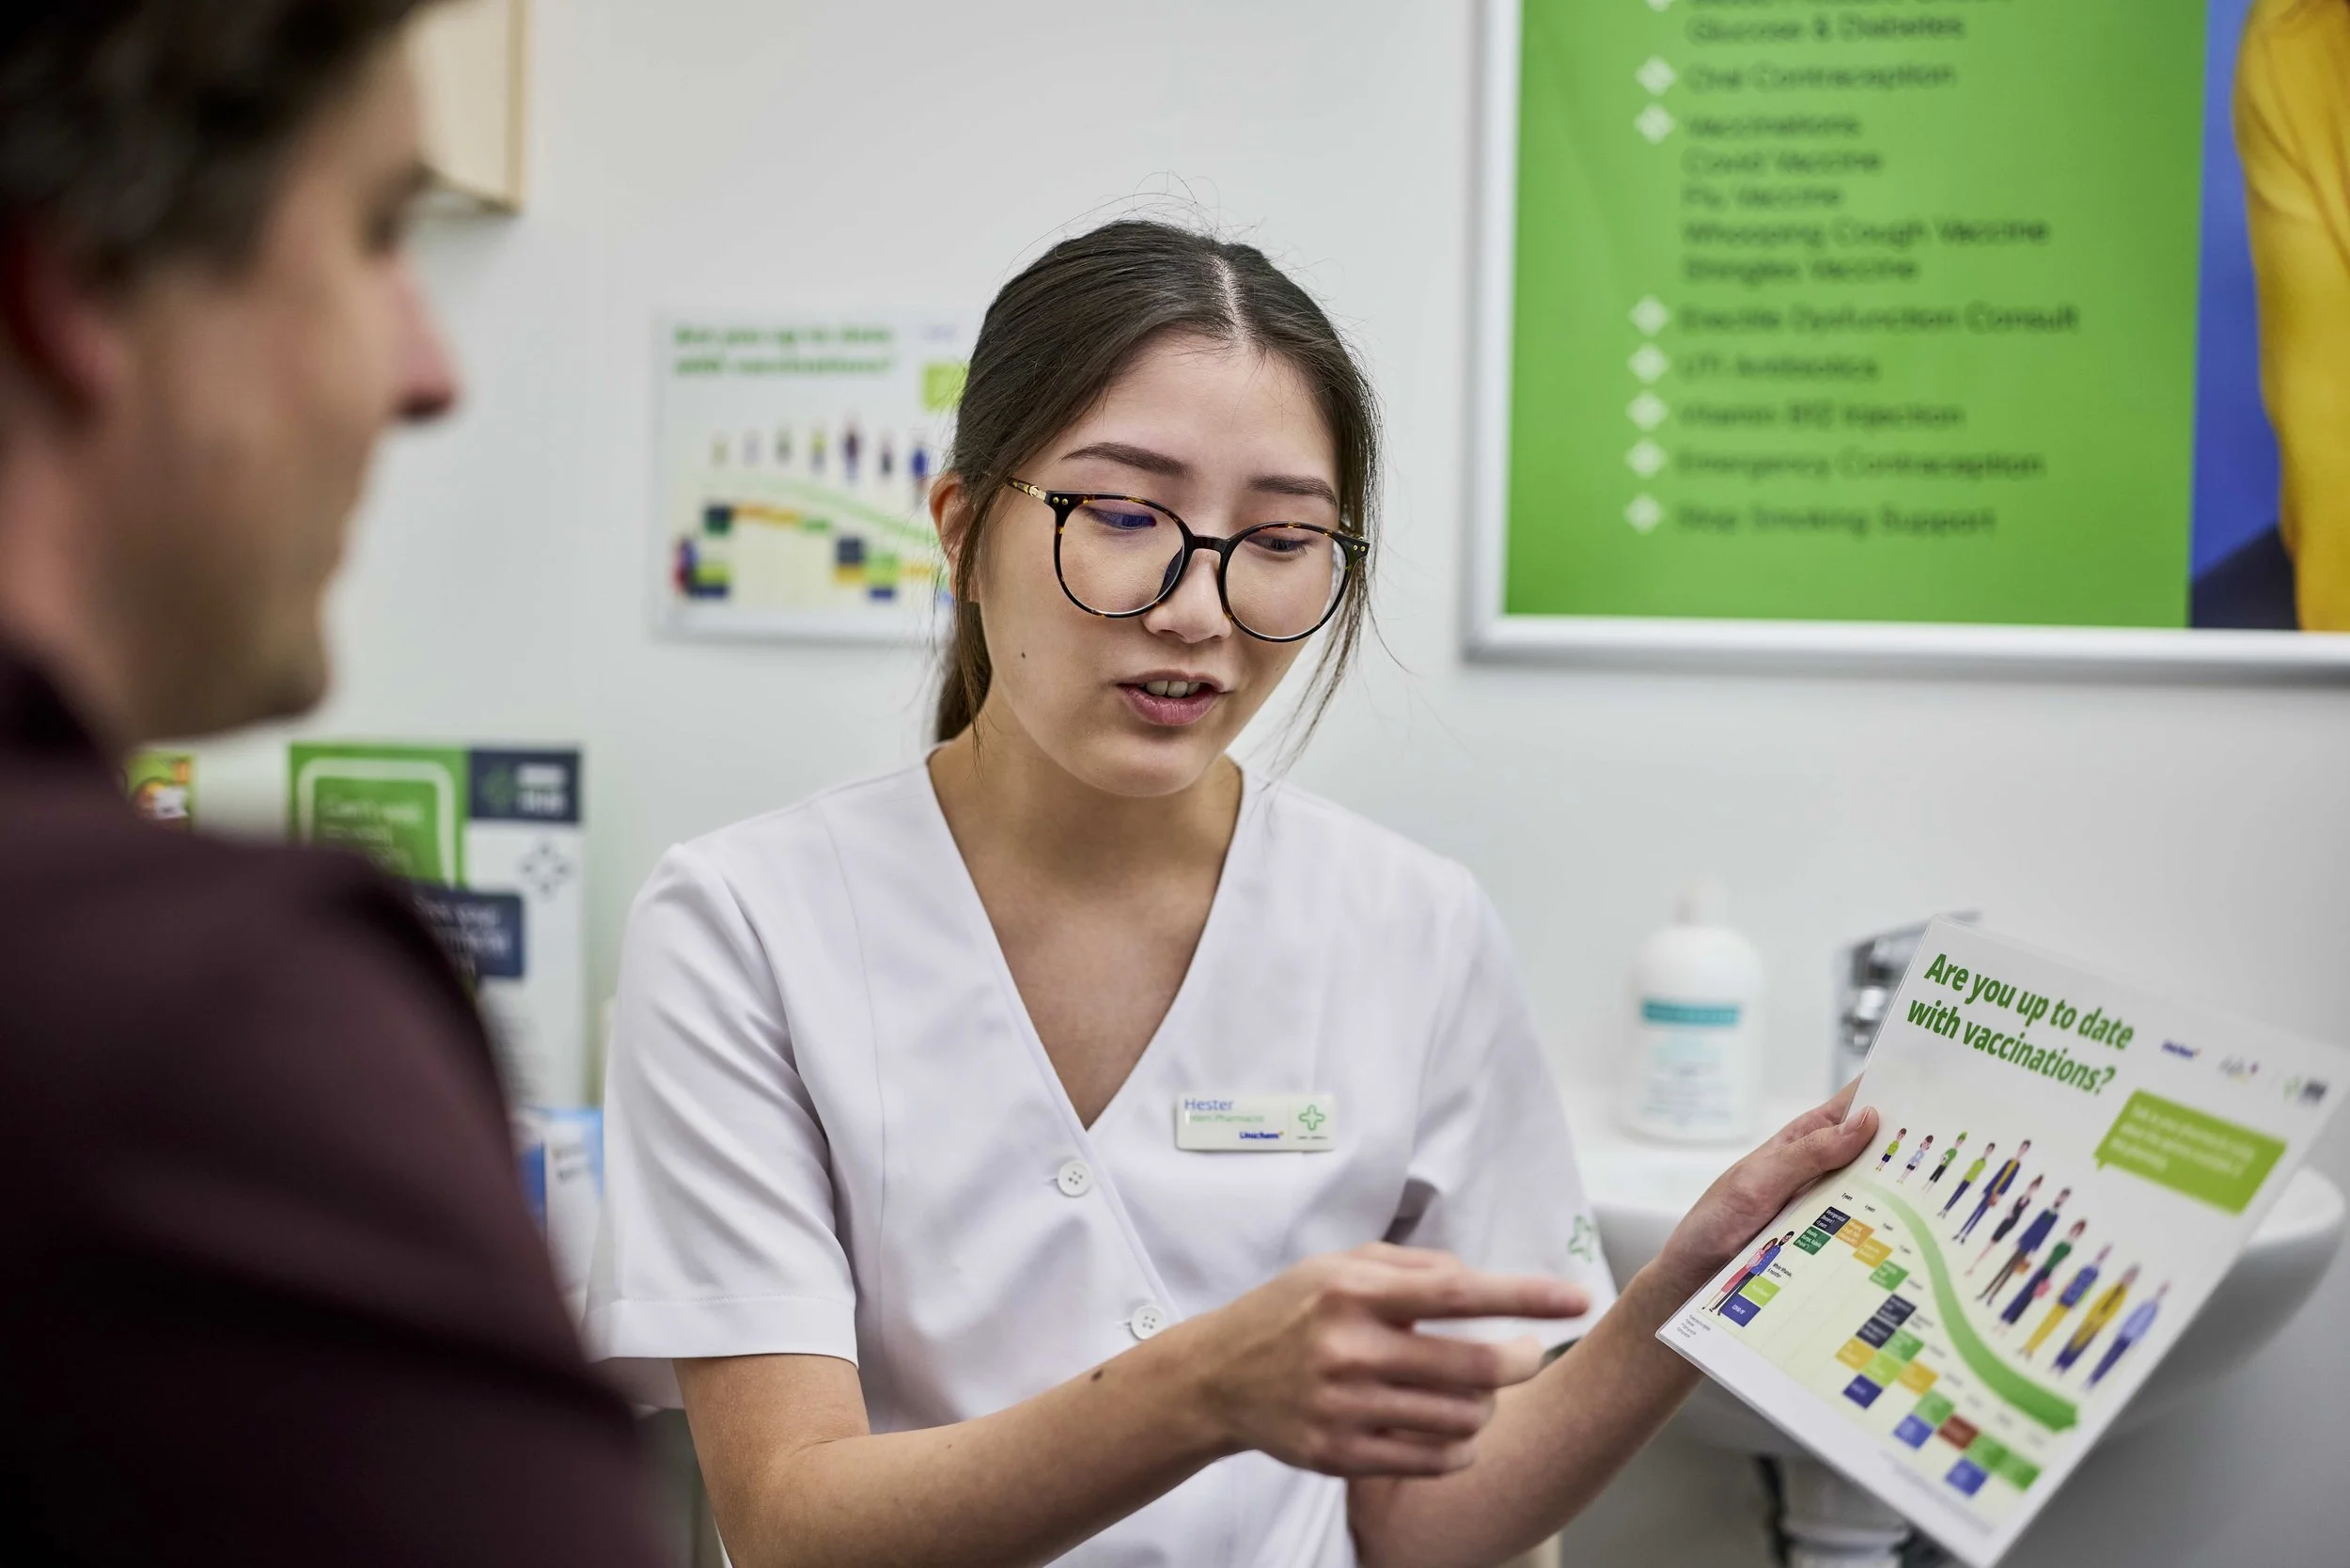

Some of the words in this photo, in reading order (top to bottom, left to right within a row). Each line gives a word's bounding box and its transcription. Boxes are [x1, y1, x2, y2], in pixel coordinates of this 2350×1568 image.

[1748, 62, 1957, 90] Contraception
[1685, 113, 1863, 138] Vaccinations
[1777, 150, 1883, 175] Vaccine
[1737, 186, 1843, 209] Vaccine
[1832, 218, 1929, 250] Cough
[1936, 219, 2050, 244] Vaccine
[1811, 259, 1919, 281] Vaccine
[1924, 952, 1969, 991] Are
[1964, 973, 2017, 1009] you
[2016, 990, 2050, 1027] up
[2049, 998, 2078, 1030] to
[2076, 1006, 2135, 1051] date
[1906, 998, 1961, 1040] with
[1963, 1020, 2117, 1096] vaccinations?
[1184, 1098, 1234, 1110] Hester
